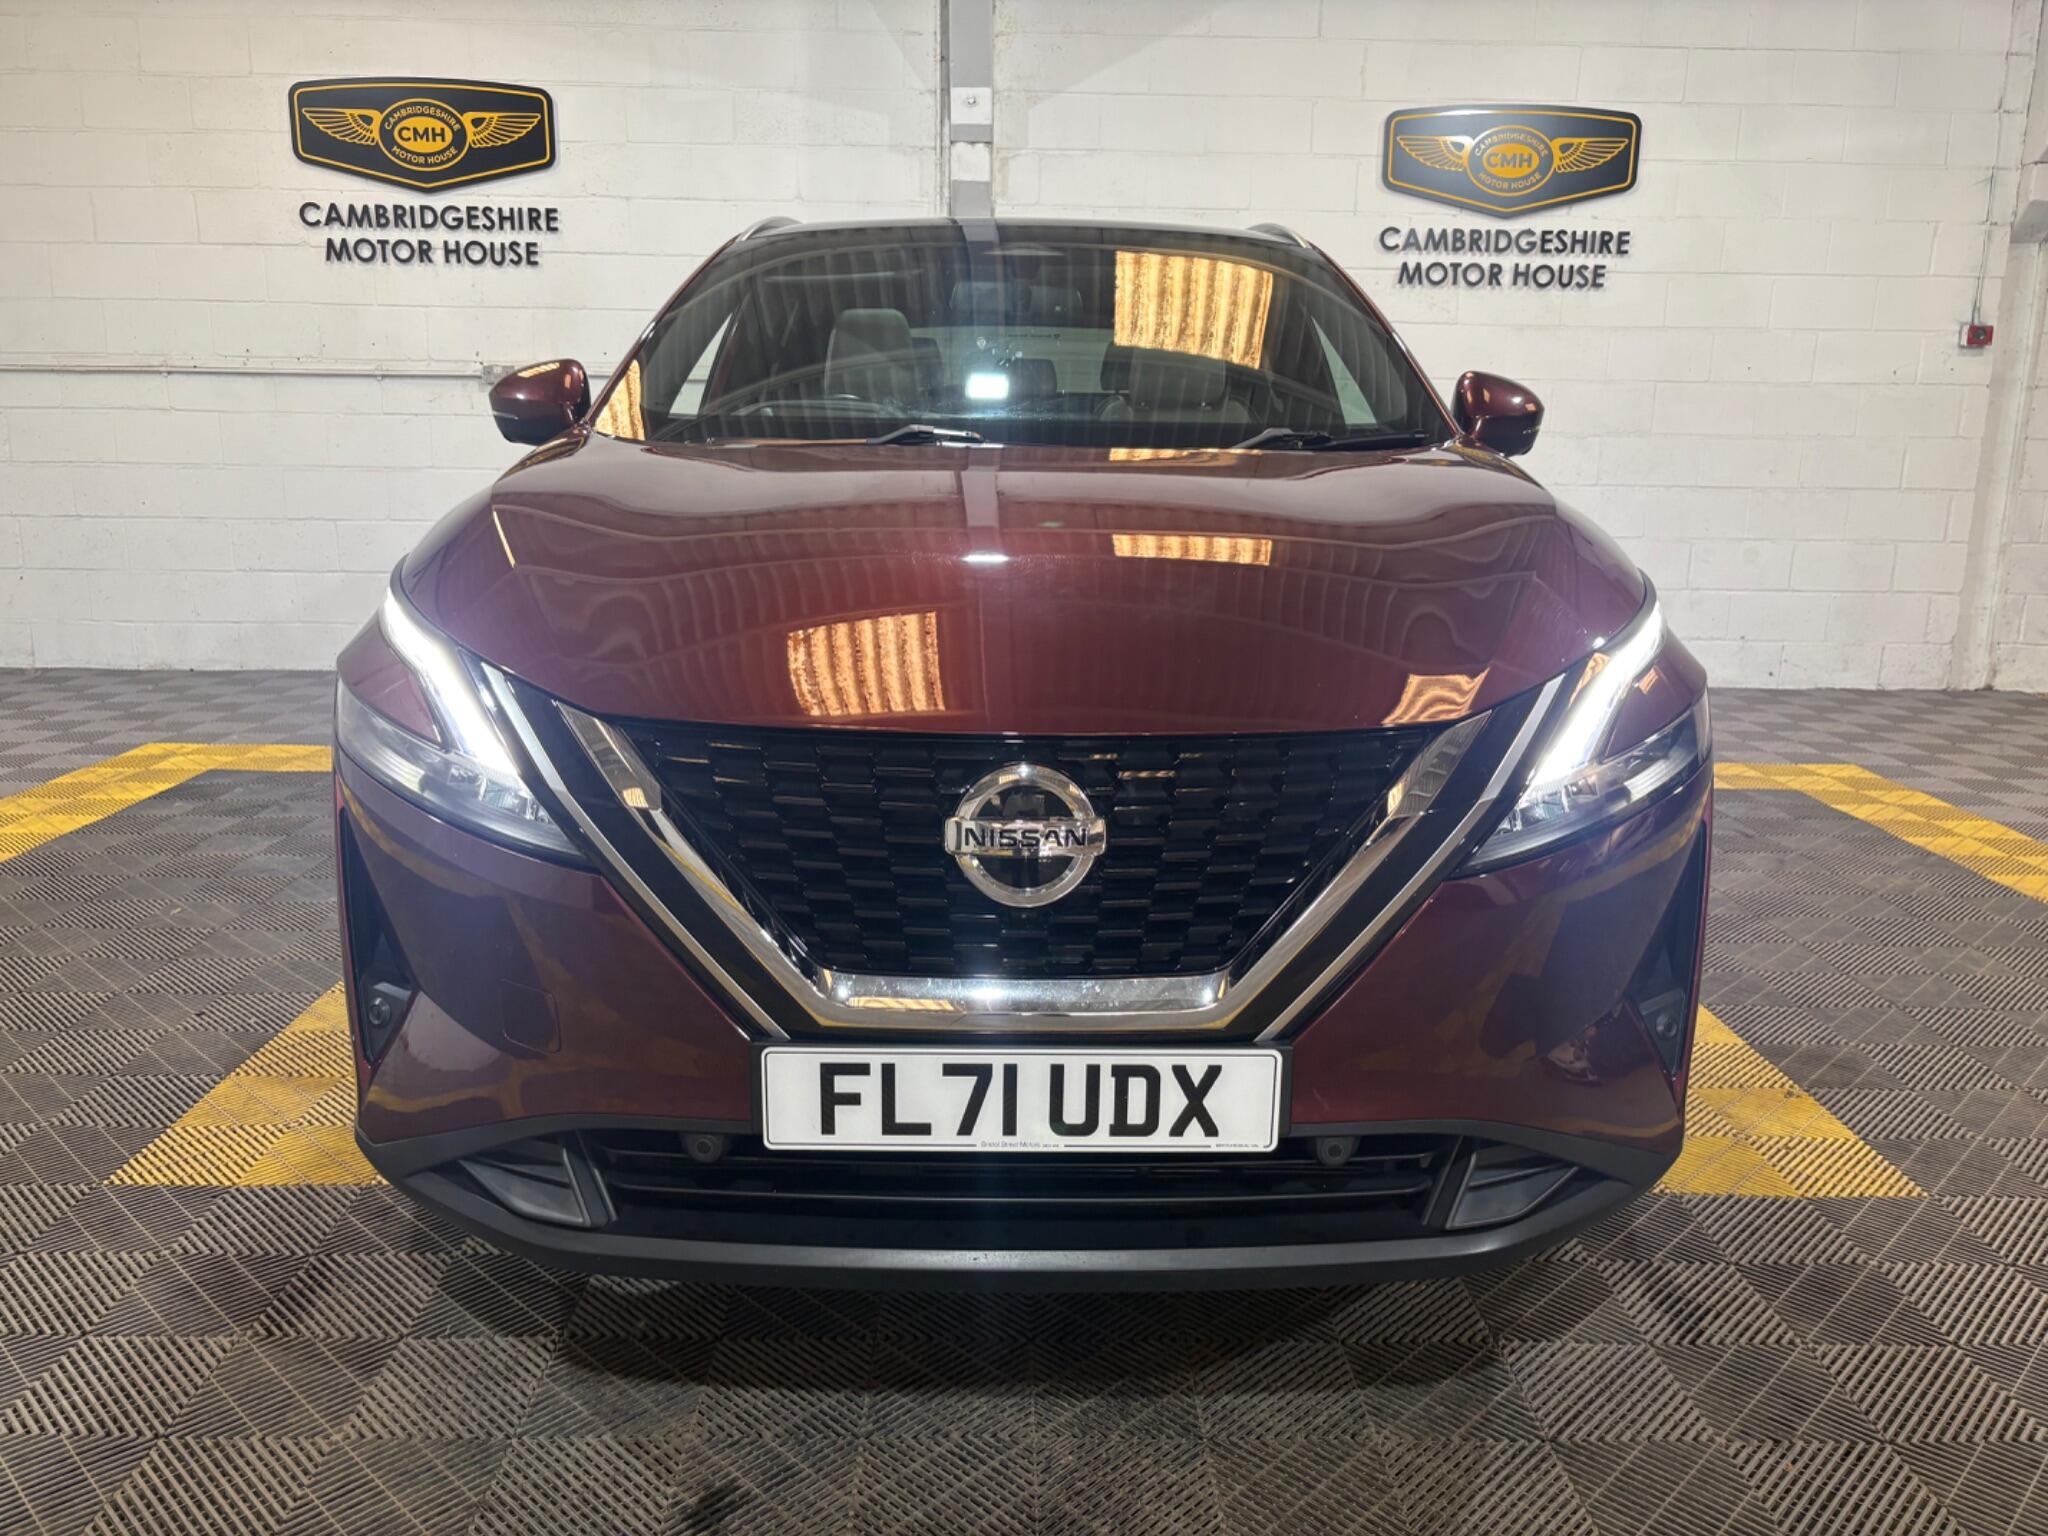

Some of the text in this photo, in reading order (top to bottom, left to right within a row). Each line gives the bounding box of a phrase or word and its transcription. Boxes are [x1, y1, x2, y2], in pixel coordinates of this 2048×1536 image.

[384, 105, 461, 131] CAMBRIDGESHIRE
[398, 126, 446, 143] CMH
[391, 145, 458, 164] MOTOR HOUSE
[1487, 152, 1533, 169] CMH
[1479, 172, 1542, 189] MOTOR HOUSE
[299, 202, 559, 232] CAMBRIDGESHIRE
[325, 238, 540, 266] MOTOR HOUSE
[1380, 226, 1631, 255] CAMBRIDGESHIRE
[1398, 262, 1607, 288] MOTOR HOUSE
[964, 828, 1087, 847] NISSAN
[819, 1062, 1223, 1137] FL71 UDX
